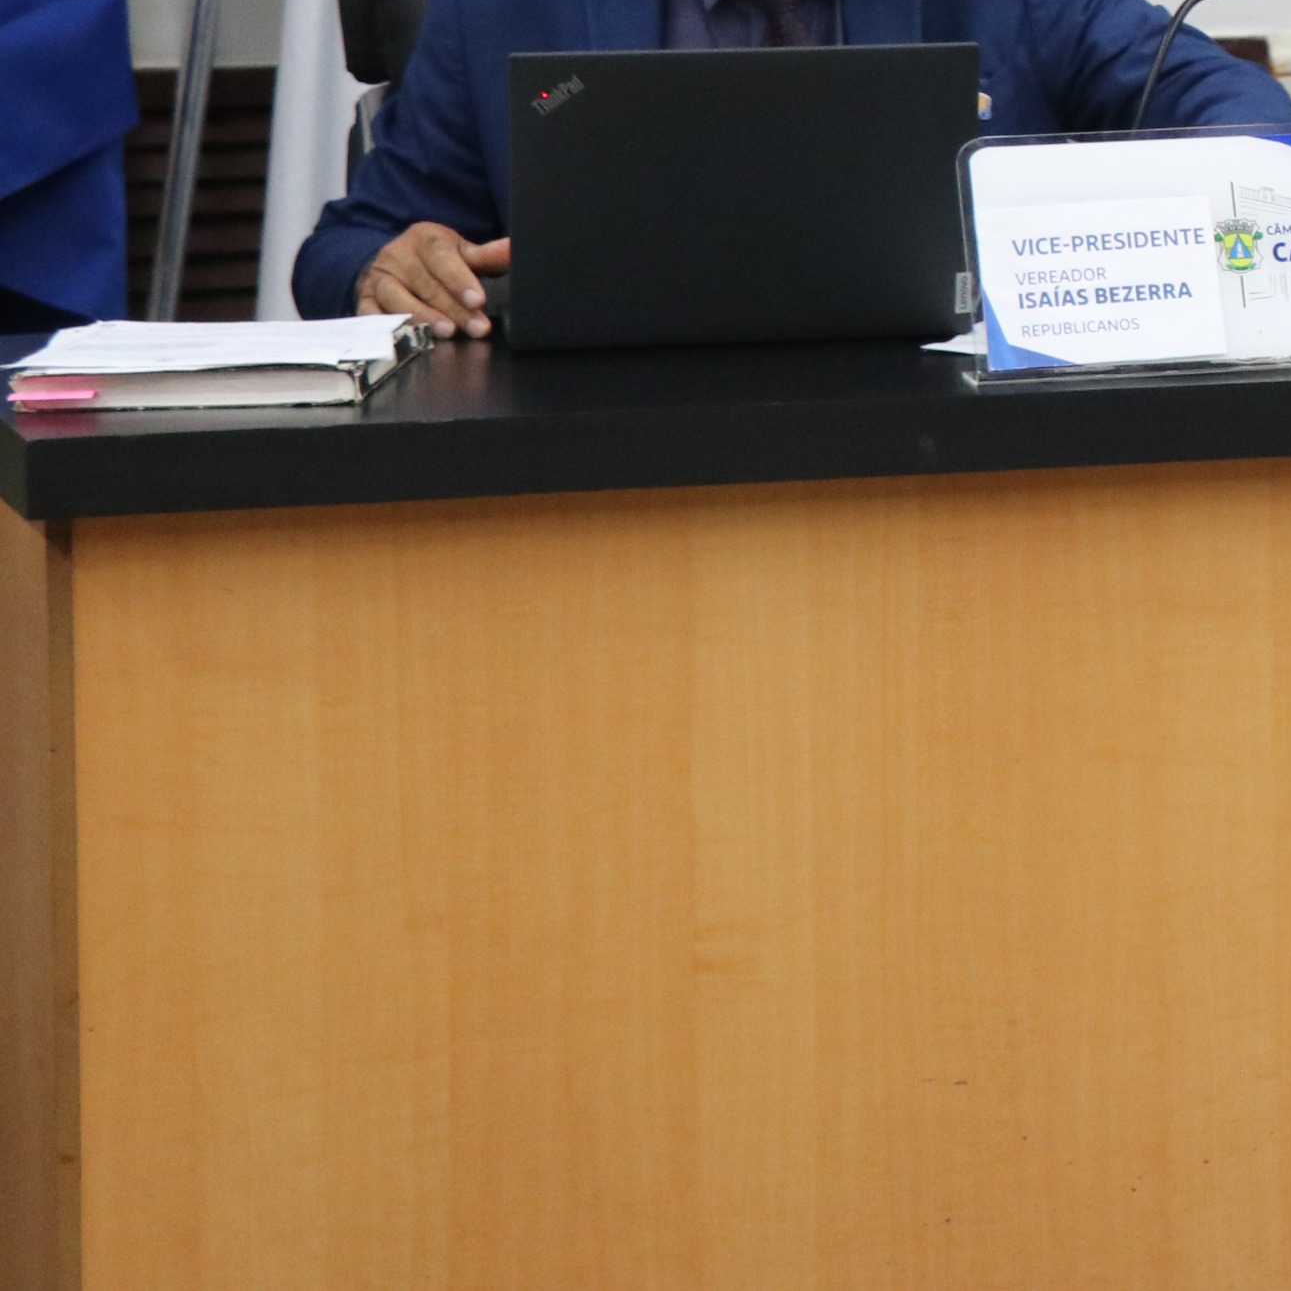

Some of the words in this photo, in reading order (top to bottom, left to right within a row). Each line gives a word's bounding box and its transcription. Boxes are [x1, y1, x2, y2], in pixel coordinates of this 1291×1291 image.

[531, 74, 585, 117] ThinkPad
[1012, 228, 1206, 257] VICE-PRESIDENTE
[1015, 267, 1107, 286] VEREADOR
[1018, 286, 1089, 309] ISAÍAS
[1095, 282, 1193, 305] BEZERRA
[1021, 317, 1140, 338] REPUBLICANOS
